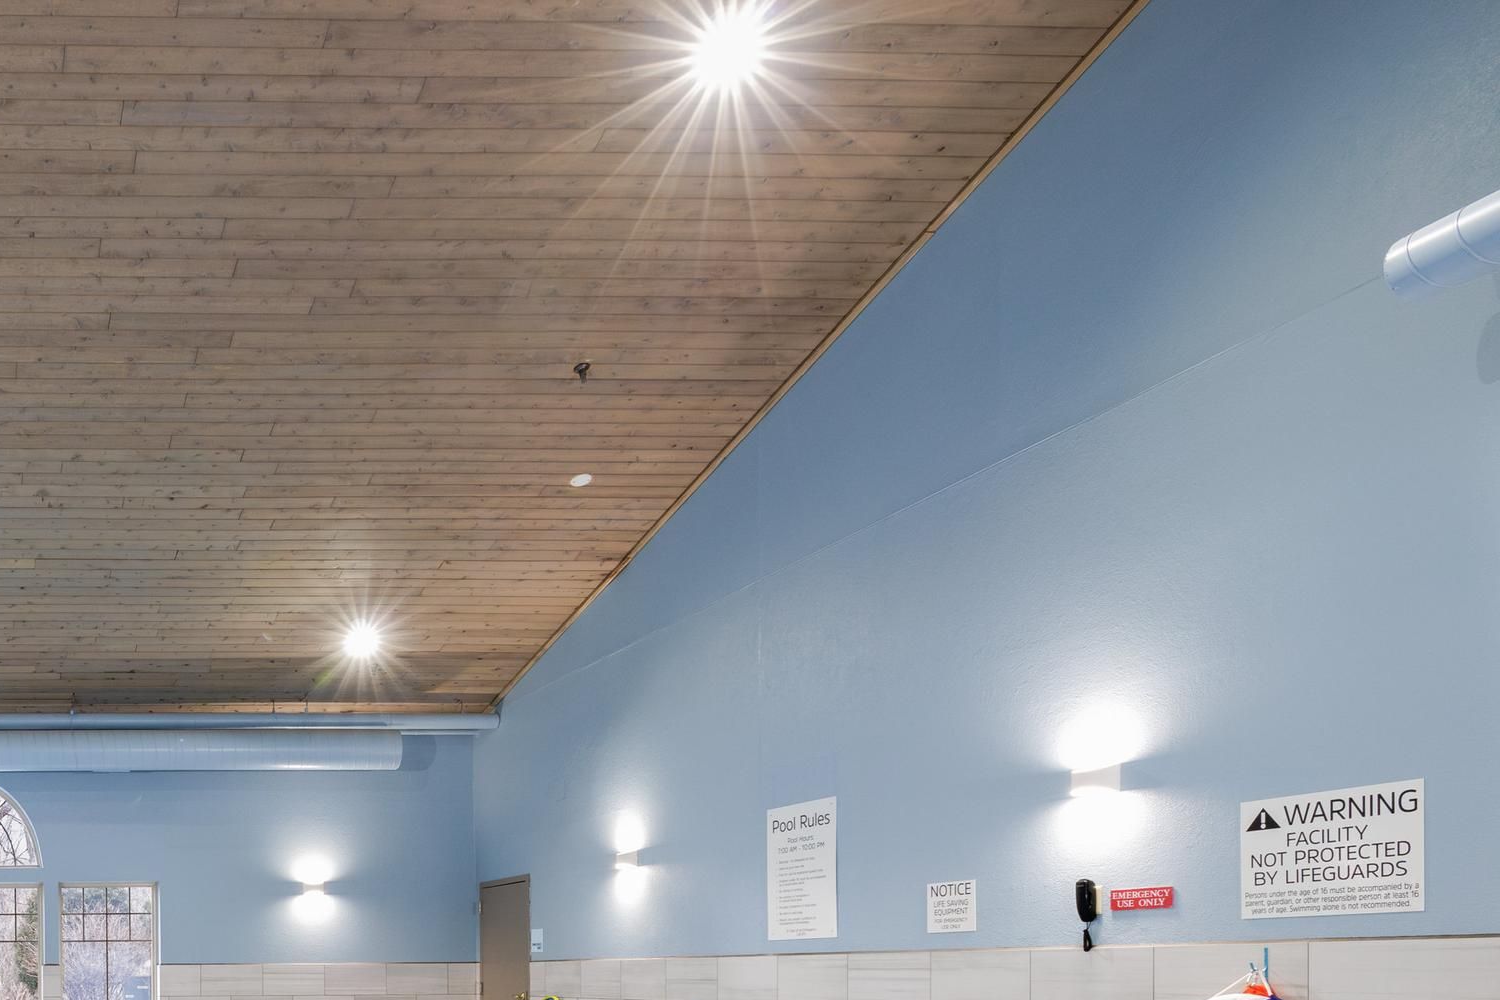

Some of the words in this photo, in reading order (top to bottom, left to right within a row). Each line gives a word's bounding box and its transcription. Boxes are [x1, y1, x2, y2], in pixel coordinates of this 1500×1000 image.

[1283, 789, 1418, 826] WARNING
[772, 816, 796, 833] Pool
[800, 812, 831, 828] Rules
[1286, 824, 1368, 847] FACILITY
[1251, 851, 1287, 869] NOT
[1295, 840, 1411, 865] PROTECTED
[1254, 870, 1278, 886] BY
[1286, 860, 1408, 884] LIFEGUARDS
[930, 882, 971, 897] NOTICE
[1112, 889, 1171, 900] EMERGENCY
[1245, 892, 1267, 900] Persons
[1300, 889, 1311, 897] age
[1321, 887, 1328, 895] 16
[1357, 883, 1402, 894] accompanied
[1404, 882, 1412, 891] by
[1321, 894, 1357, 903] responsible
[1358, 893, 1382, 902] person
[1392, 891, 1408, 899] least
[1412, 890, 1419, 898] 16
[933, 900, 946, 908] LIFE
[947, 898, 969, 907] SAVING
[1116, 899, 1134, 908] USE
[1138, 898, 1165, 907] ONLY
[1252, 907, 1267, 915] years
[1290, 904, 1321, 913] Swimming
[1322, 903, 1340, 911] alone
[1348, 902, 1359, 910] not
[934, 907, 968, 917] EQUIPMENT
